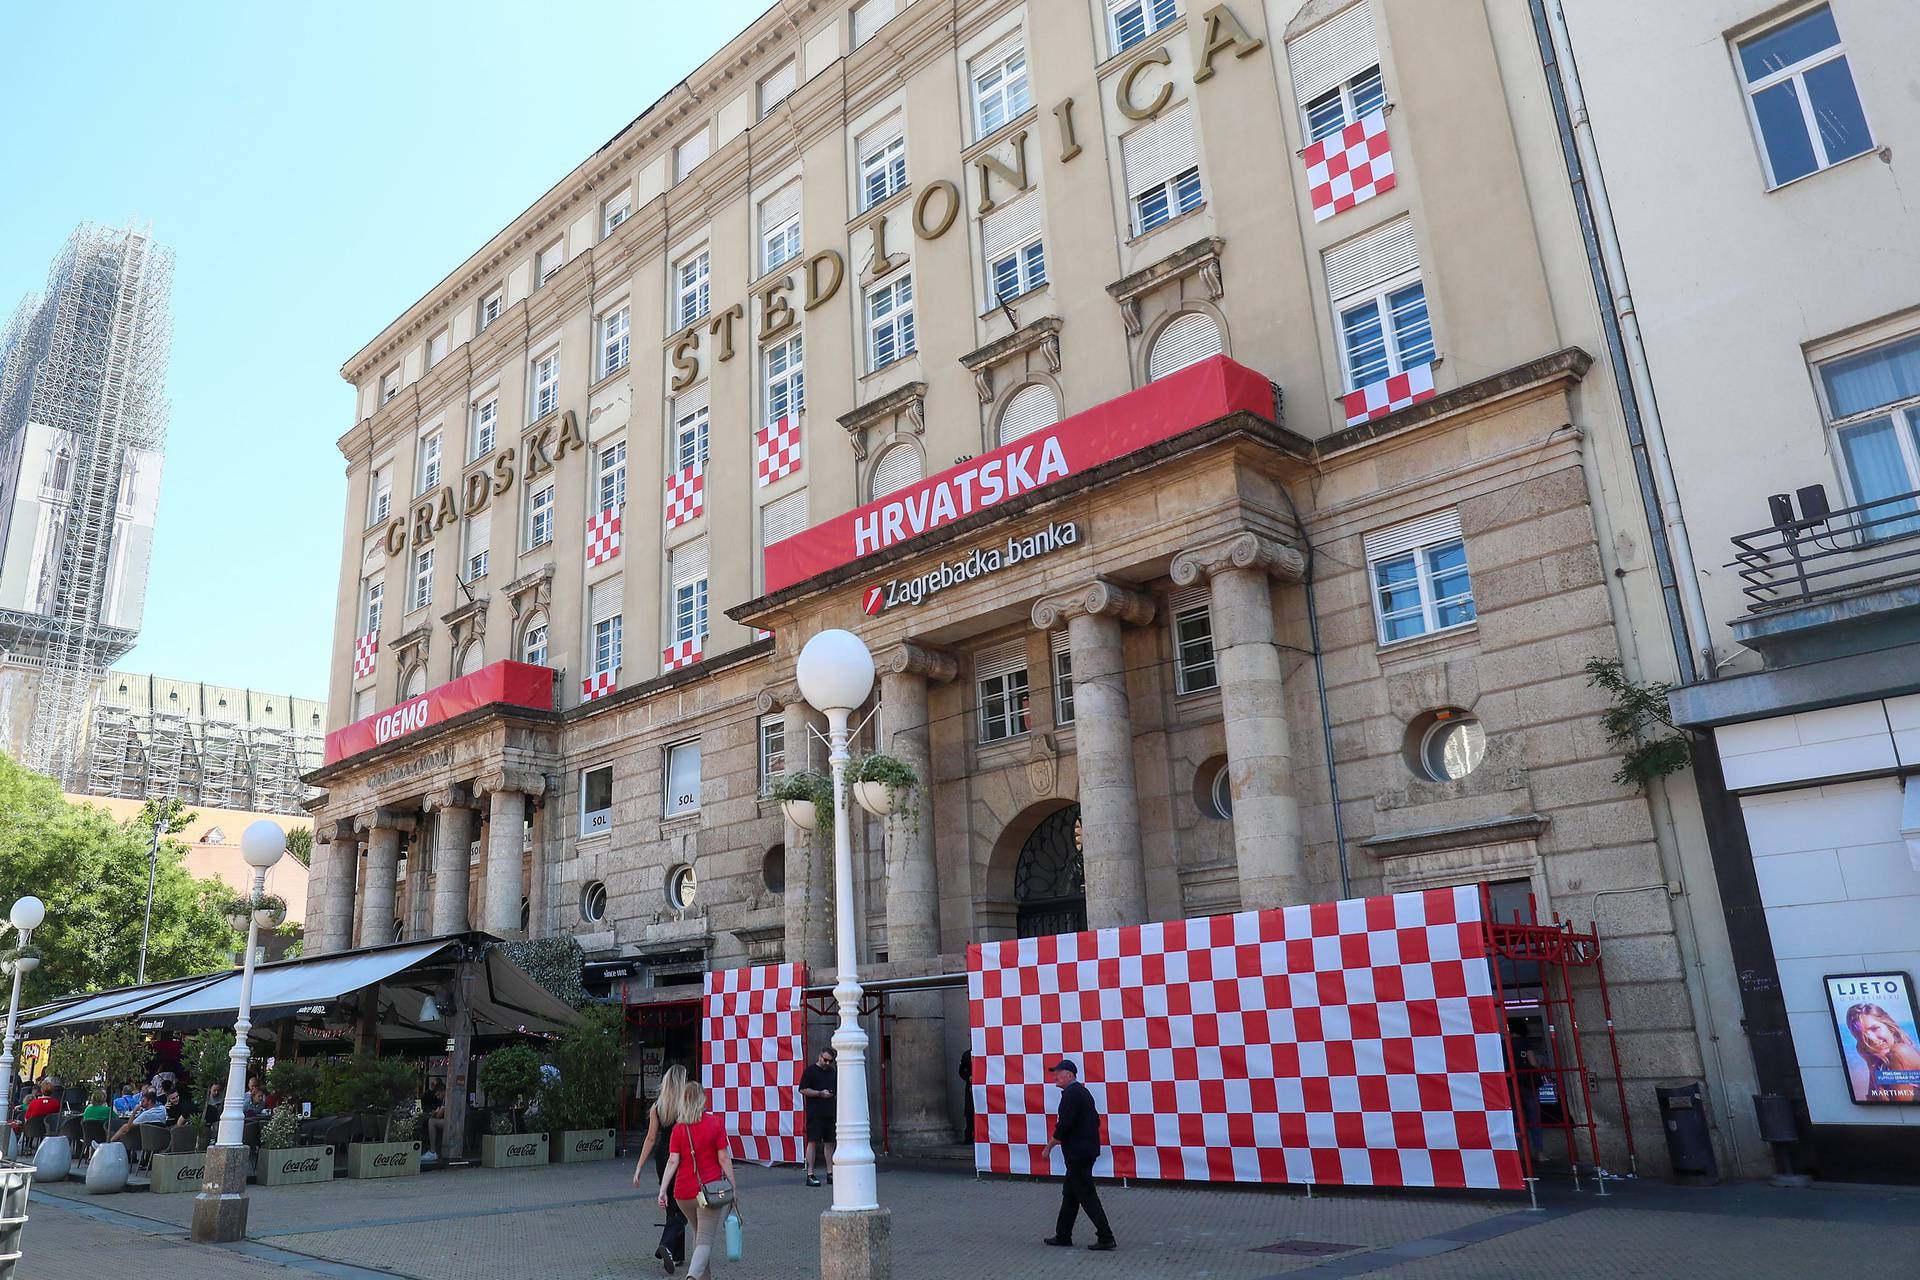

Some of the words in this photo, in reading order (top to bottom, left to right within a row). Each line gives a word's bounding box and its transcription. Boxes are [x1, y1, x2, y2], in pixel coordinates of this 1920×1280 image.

[385, 410, 584, 557] GRADSKA
[855, 436, 1069, 557] HRVATSKA
[884, 548, 1000, 610] Zagrebačka
[1007, 521, 1078, 565] banka
[375, 699, 428, 745] IDEMO
[592, 815, 606, 827] SOL
[679, 793, 694, 806] SOL
[1837, 981, 1898, 996] LJETO
